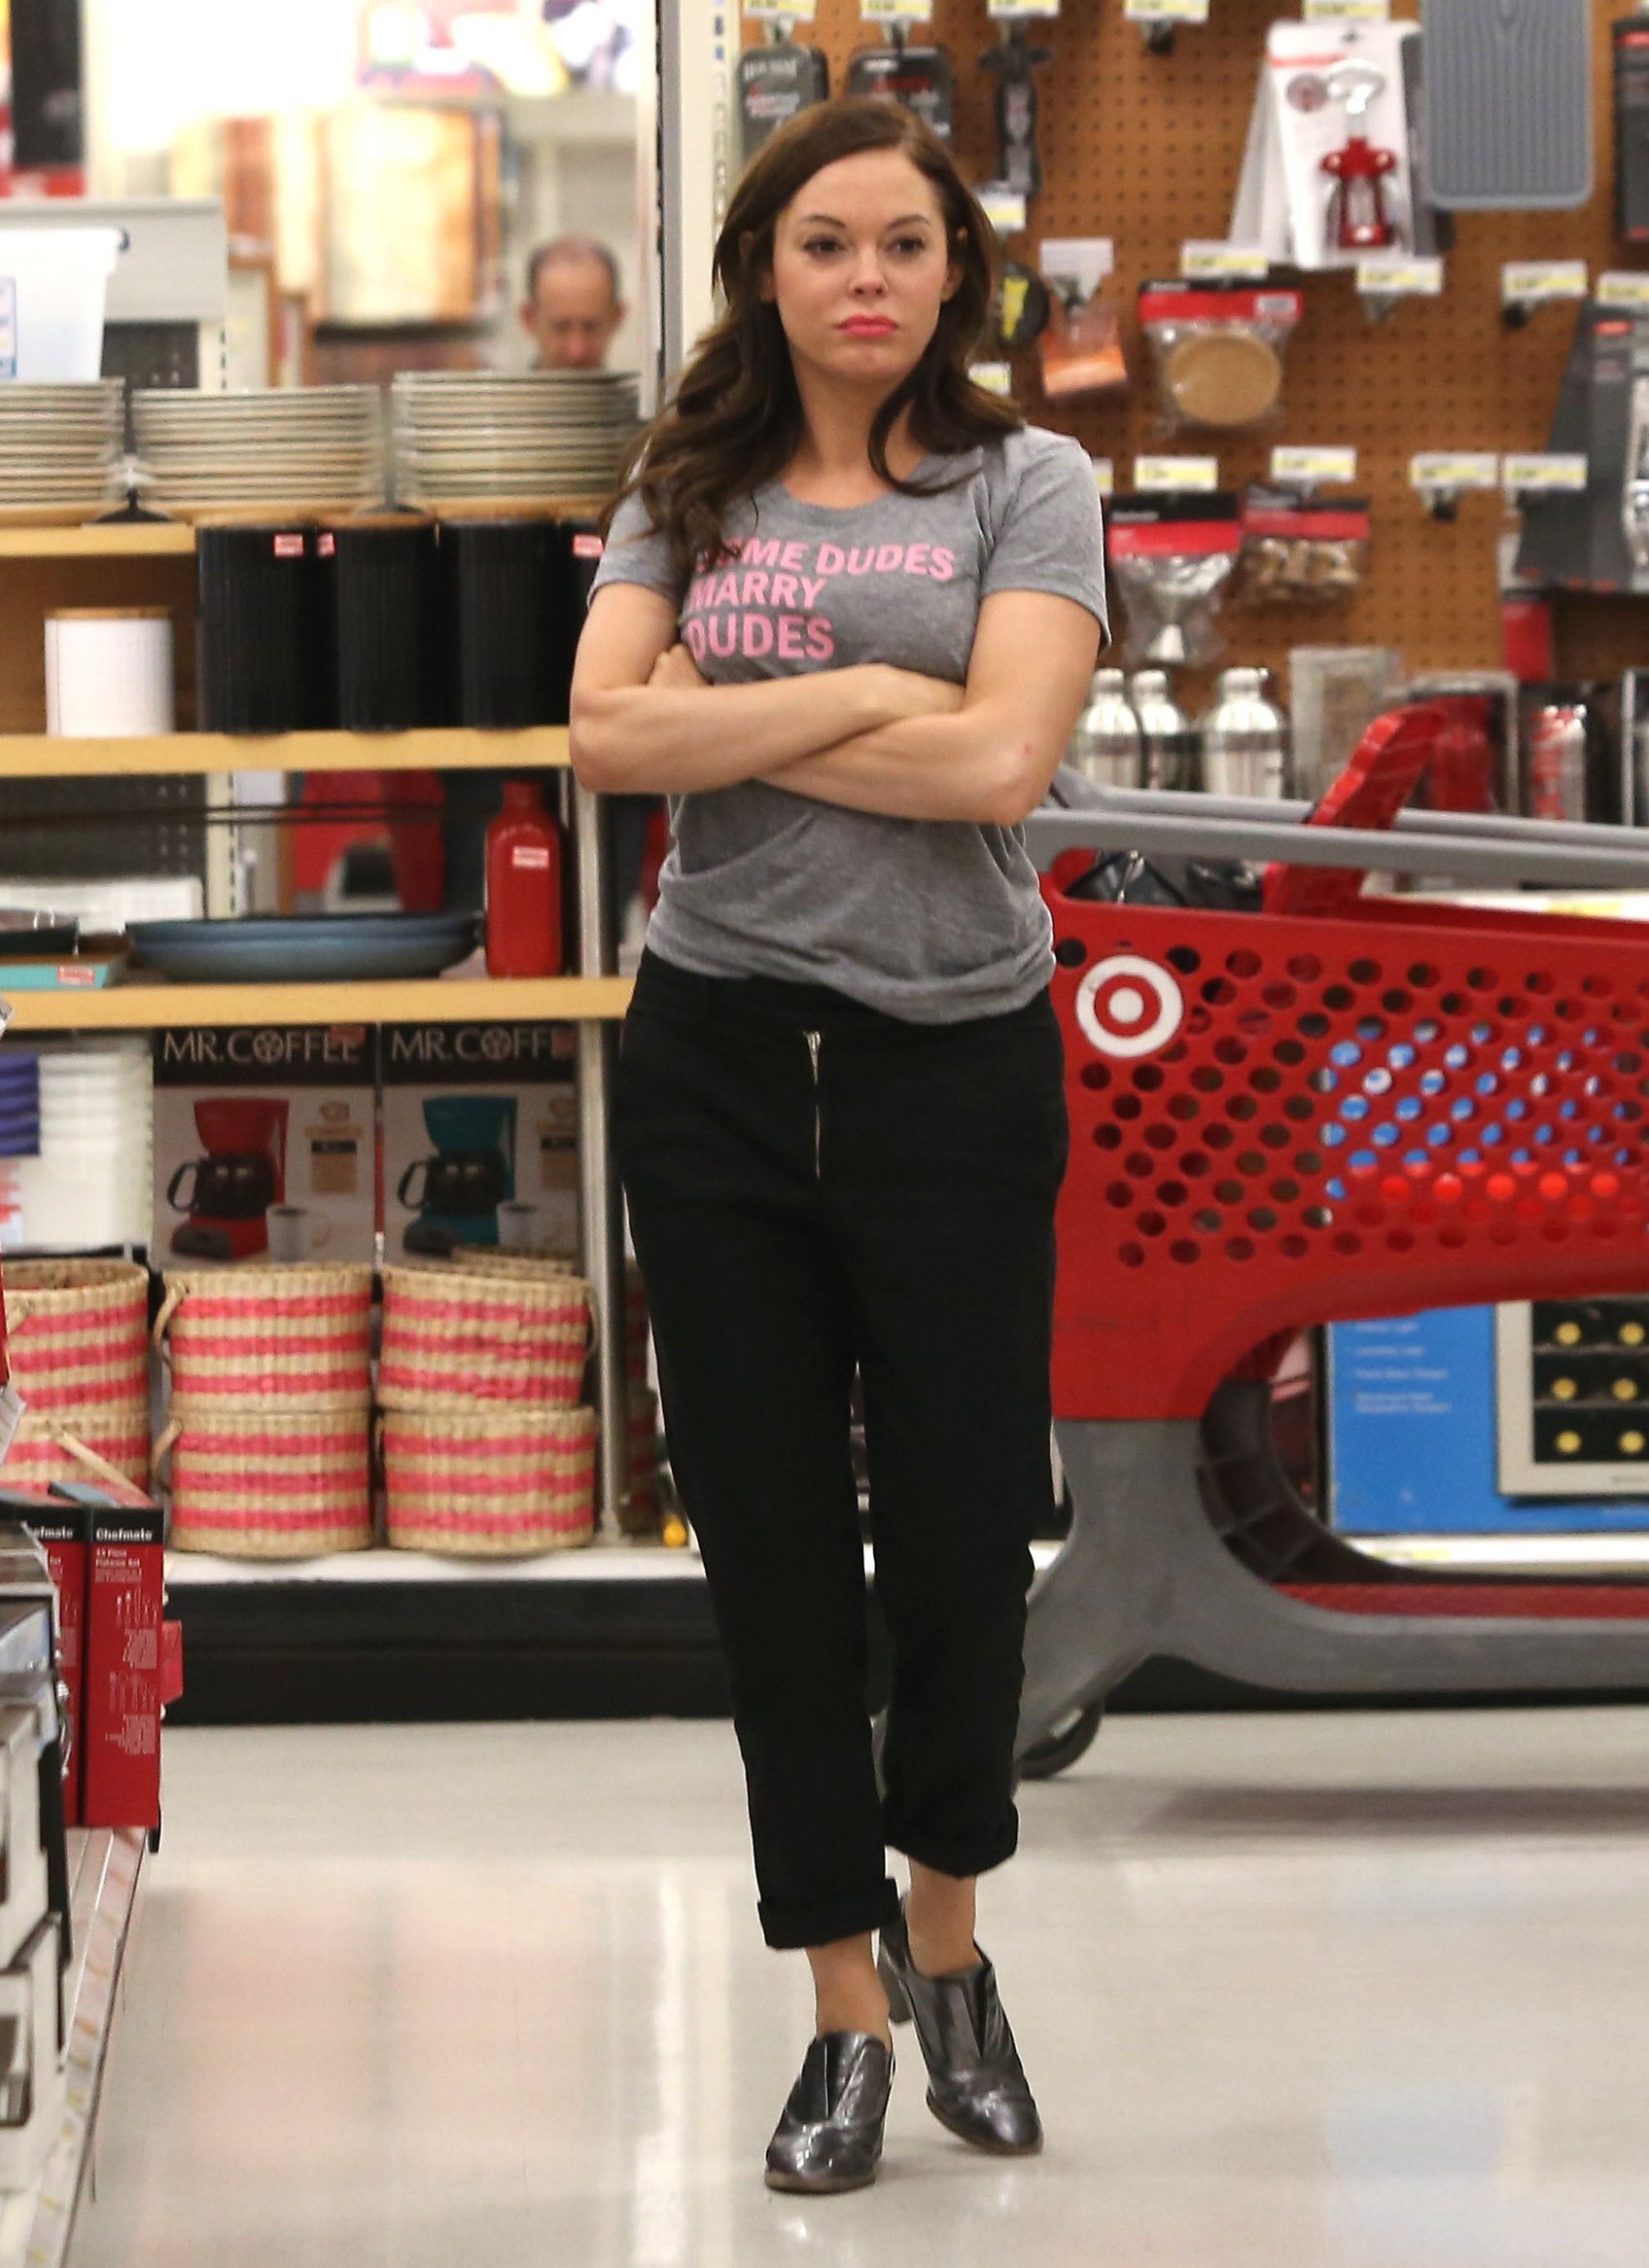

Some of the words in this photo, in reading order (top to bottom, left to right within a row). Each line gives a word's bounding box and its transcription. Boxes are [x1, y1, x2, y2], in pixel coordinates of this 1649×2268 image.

[695, 538, 809, 573] ME
[815, 544, 955, 581] DUDES
[685, 613, 835, 661] DUDES
[96, 1527, 153, 1542] Chefmate
